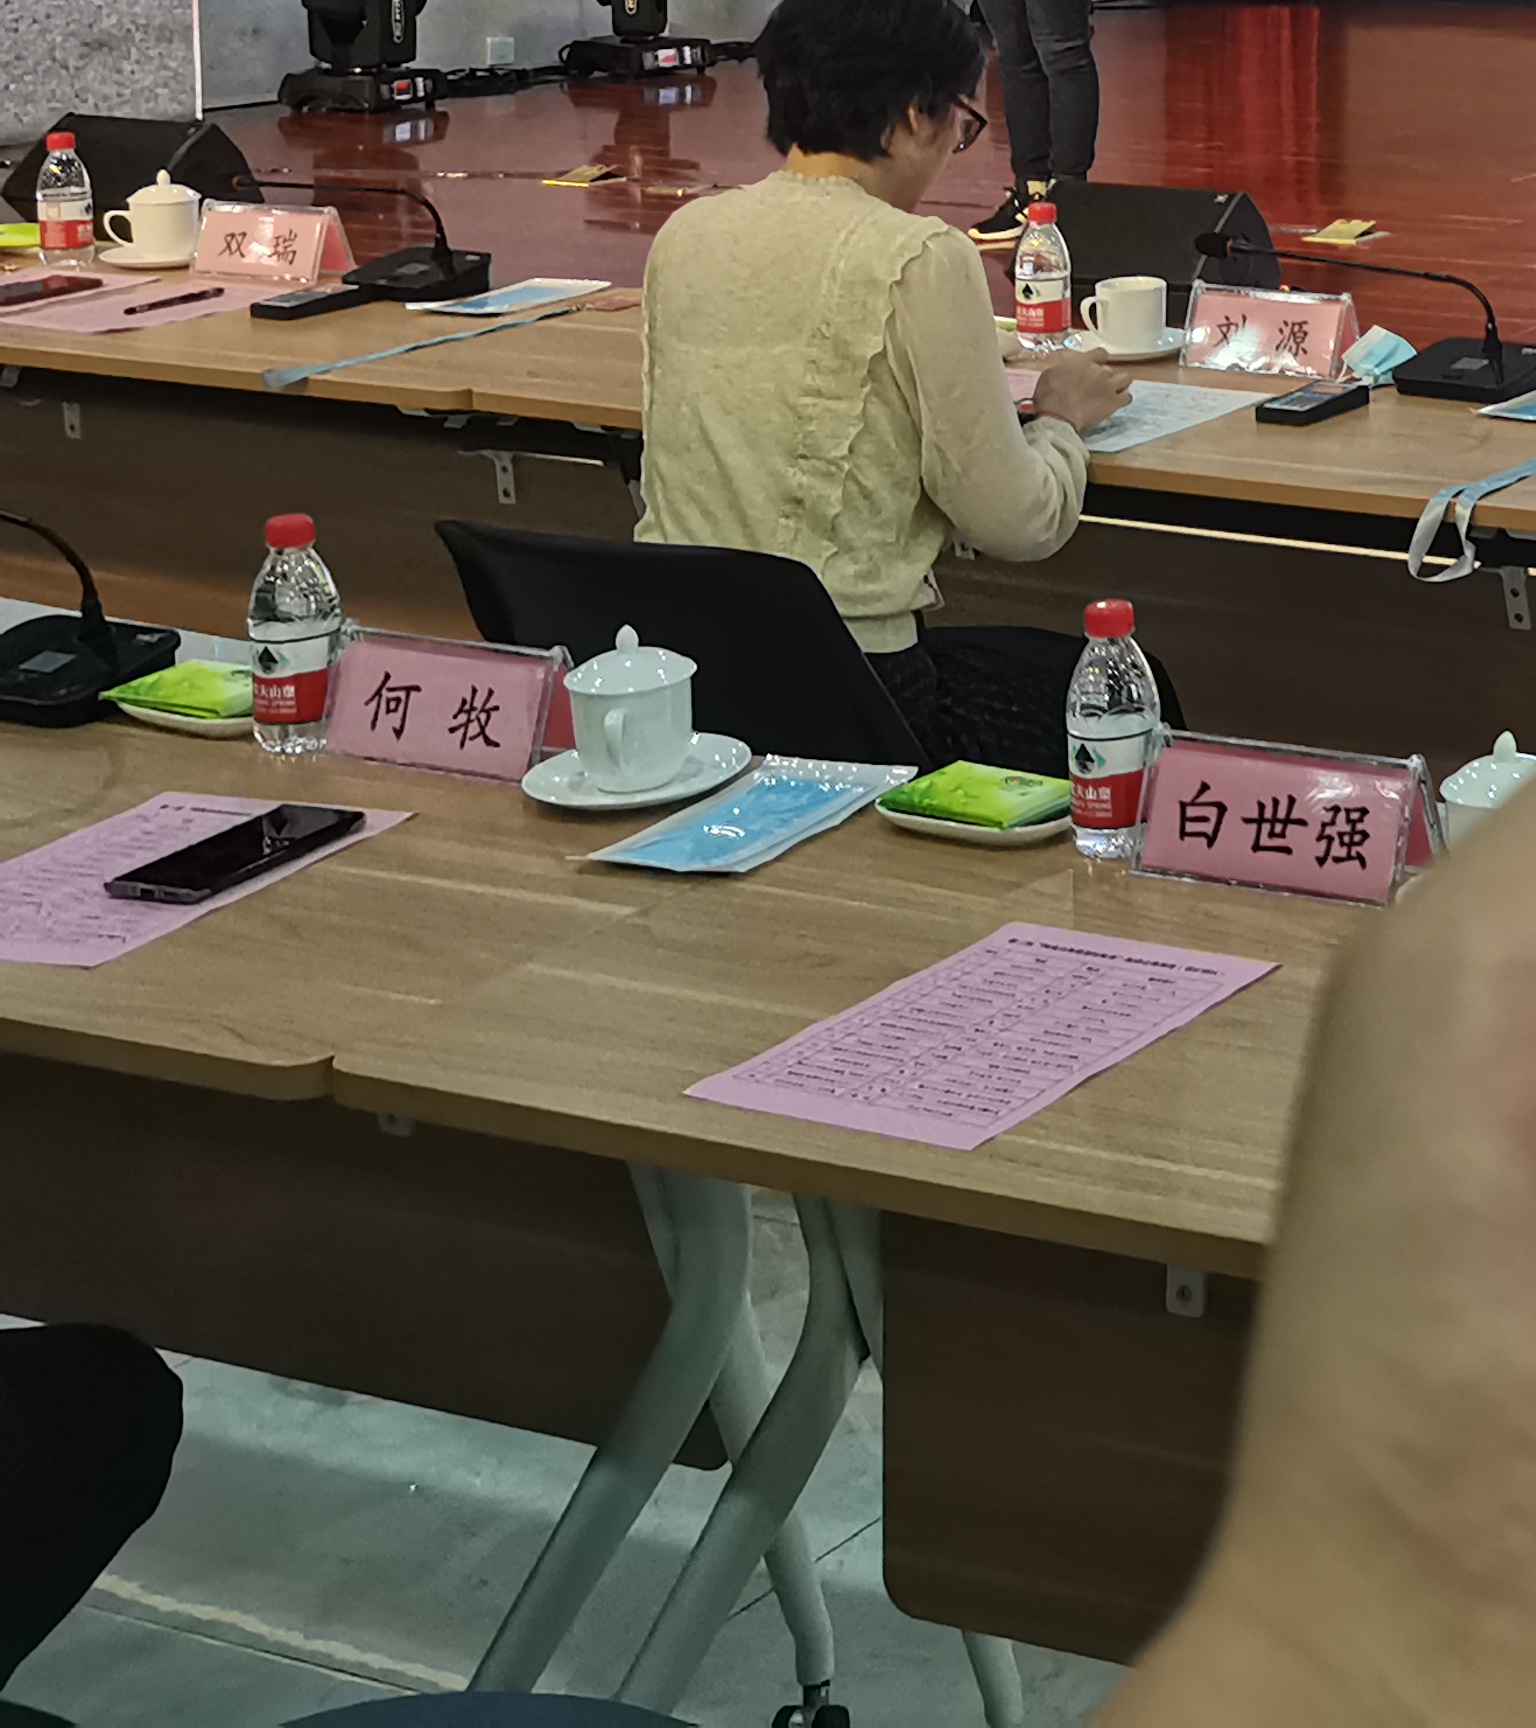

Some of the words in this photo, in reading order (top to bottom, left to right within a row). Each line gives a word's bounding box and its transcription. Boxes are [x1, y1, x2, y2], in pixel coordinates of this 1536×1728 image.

[217, 228, 298, 266] 双瑞
[363, 670, 502, 751] 何牧
[1177, 780, 1371, 871] 白世强
